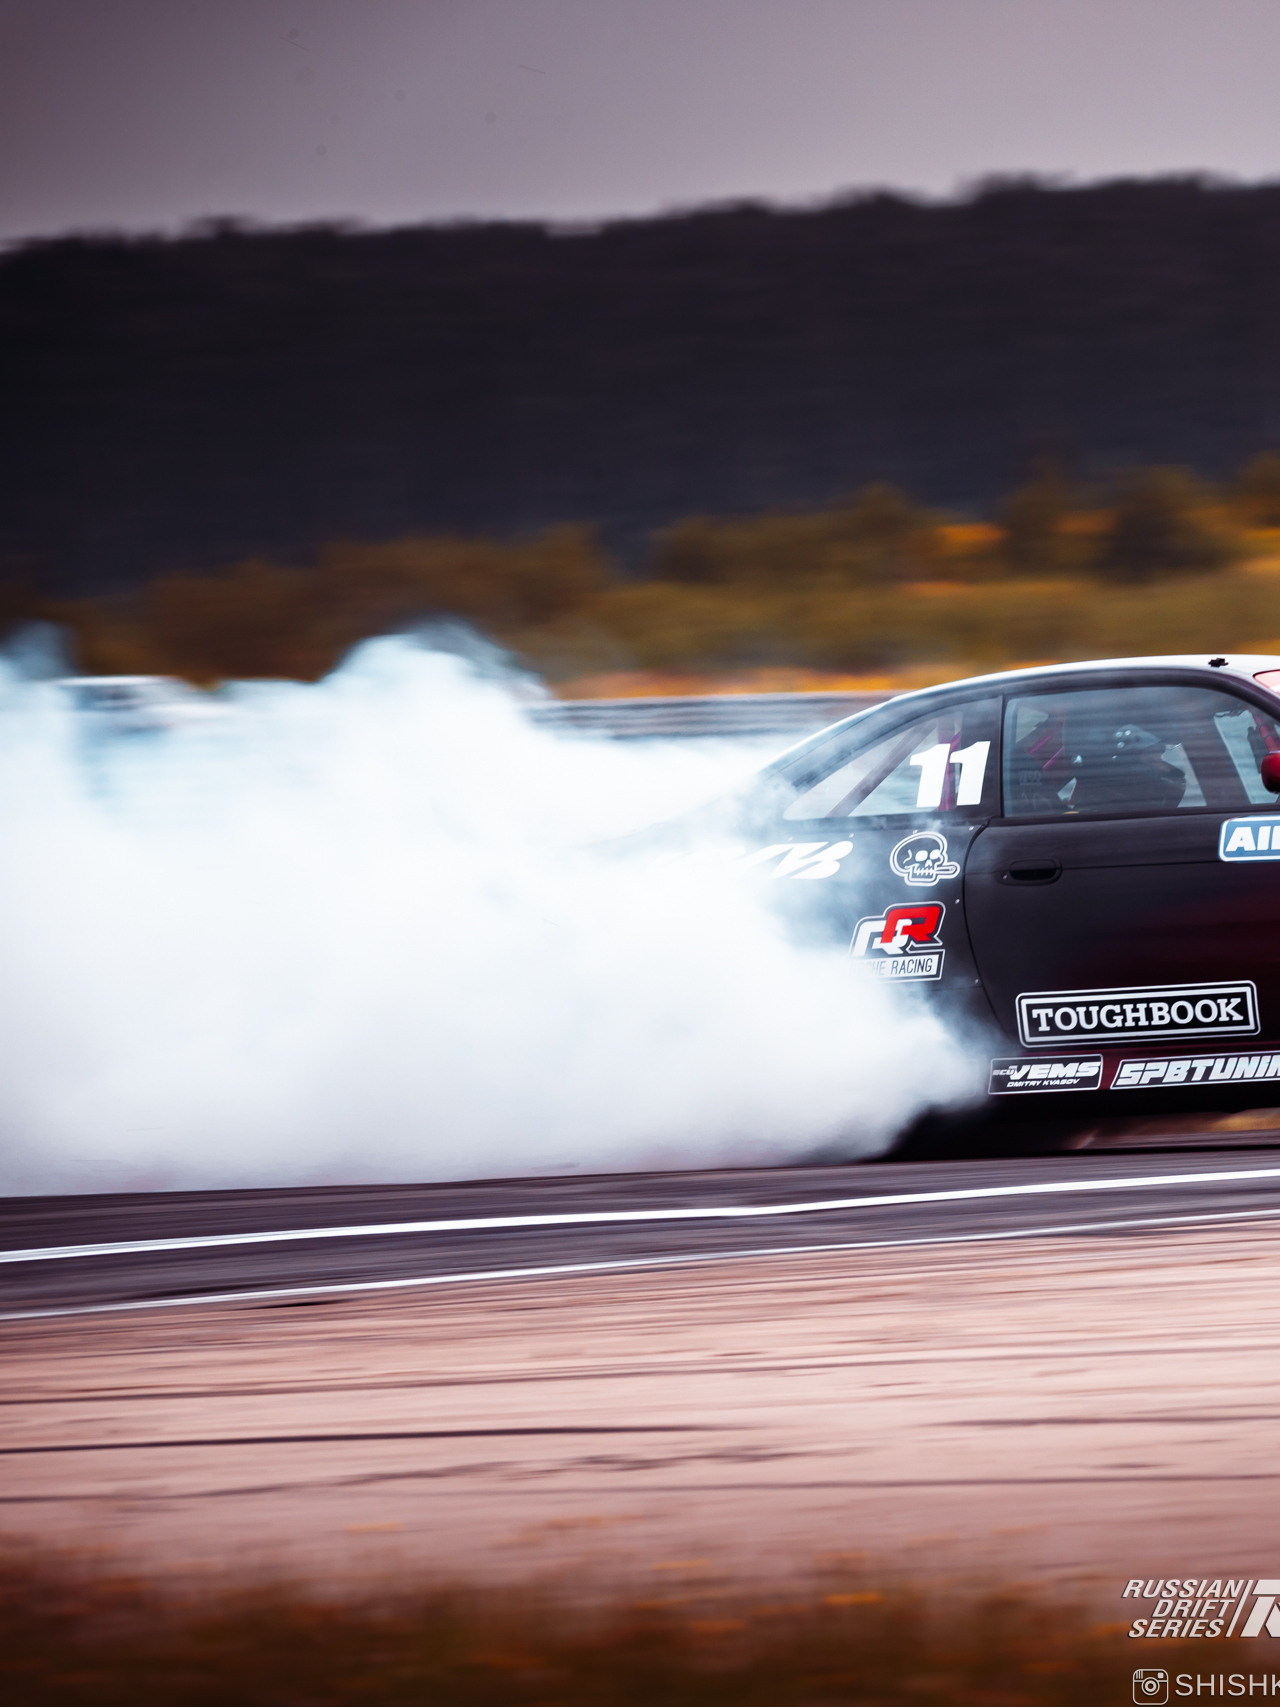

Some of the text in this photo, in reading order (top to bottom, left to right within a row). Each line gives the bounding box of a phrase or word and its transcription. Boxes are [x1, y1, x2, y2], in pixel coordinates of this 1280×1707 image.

[910, 741, 990, 808] 11
[891, 958, 933, 975] RACING
[1032, 997, 1243, 1032] TOUGHBOOK
[1009, 1061, 1102, 1081] VEMS
[1006, 1078, 1080, 1088] DMITRY KVASOV
